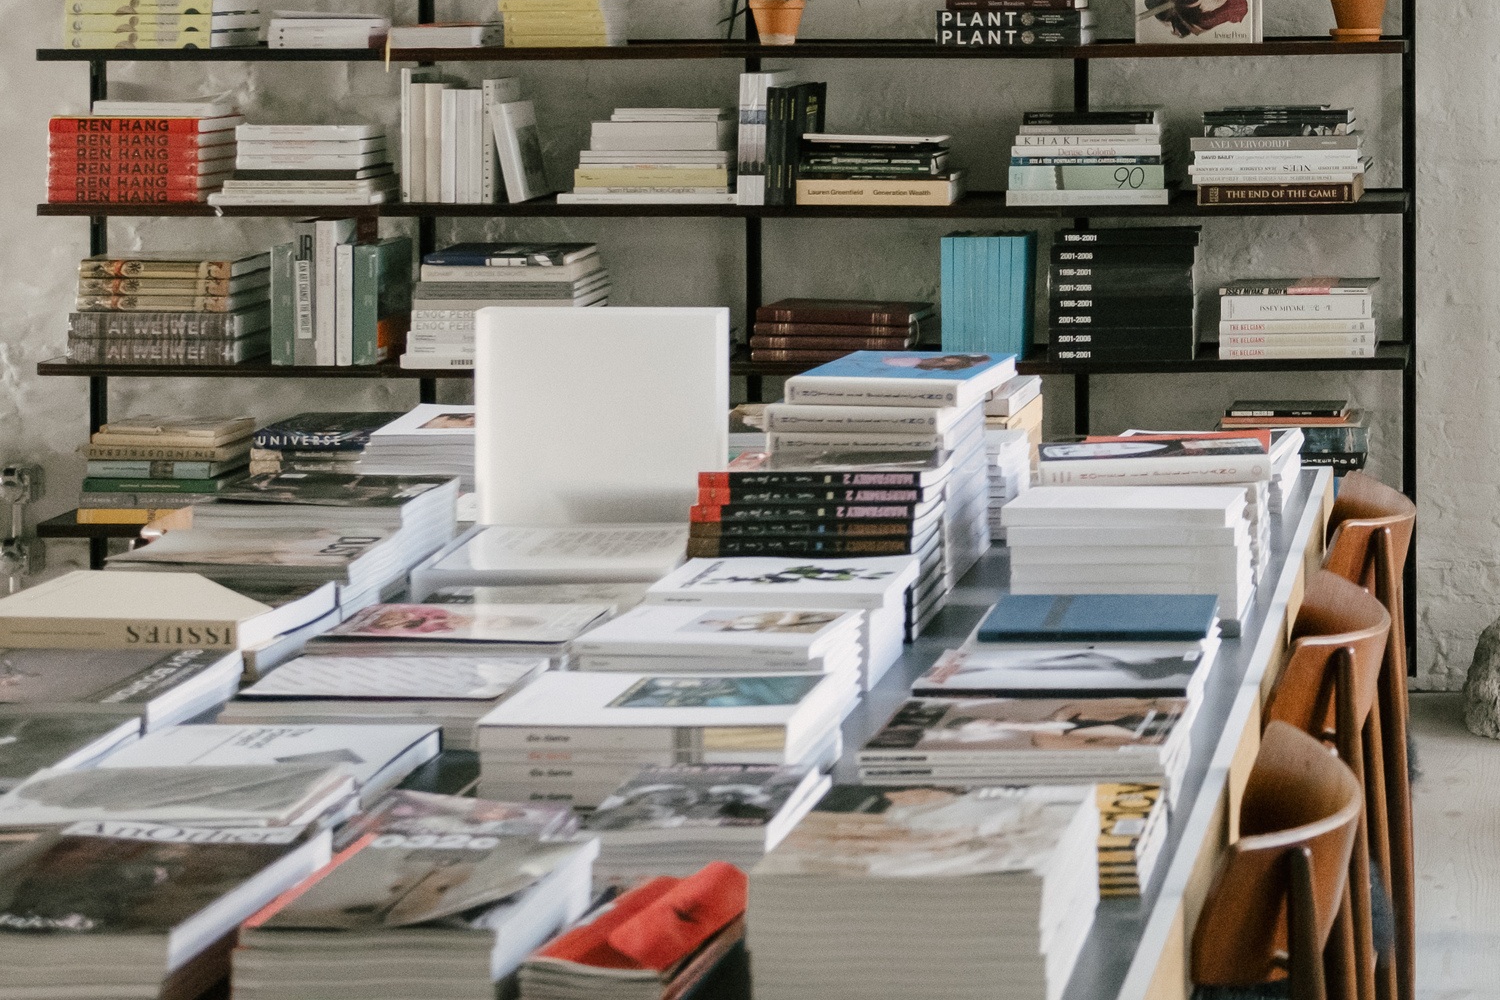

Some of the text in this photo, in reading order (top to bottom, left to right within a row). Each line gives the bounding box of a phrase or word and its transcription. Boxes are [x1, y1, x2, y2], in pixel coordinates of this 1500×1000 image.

[942, 12, 1017, 26] PLANT
[942, 30, 1017, 45] PLANT
[78, 120, 170, 132] REN HANG
[76, 134, 168, 146] REN HANG
[1024, 137, 1080, 145] KHAKI
[1210, 140, 1291, 148] AXEL VERVOORDT
[76, 148, 168, 160] REN HANG
[1058, 148, 1116, 156] Denise Colomb
[76, 163, 168, 174] REN HANG
[1282, 164, 1311, 172] NUES
[76, 176, 168, 188] REN HANG
[1114, 166, 1145, 189] 90
[76, 191, 168, 203] REN HANG
[1226, 189, 1337, 198] THE END OF THE GAME
[295, 234, 312, 261] JR
[299, 262, 308, 272] CAN
[416, 310, 476, 318] ENOC PERE
[134, 320, 206, 334] WEIWEI
[416, 322, 476, 330] ENOC PERE
[133, 346, 205, 359] WEIWEI
[258, 435, 341, 446] UNIVERSE
[194, 448, 216, 458] EIN
[126, 626, 231, 645] ISSUES
[370, 834, 500, 849] 032c
